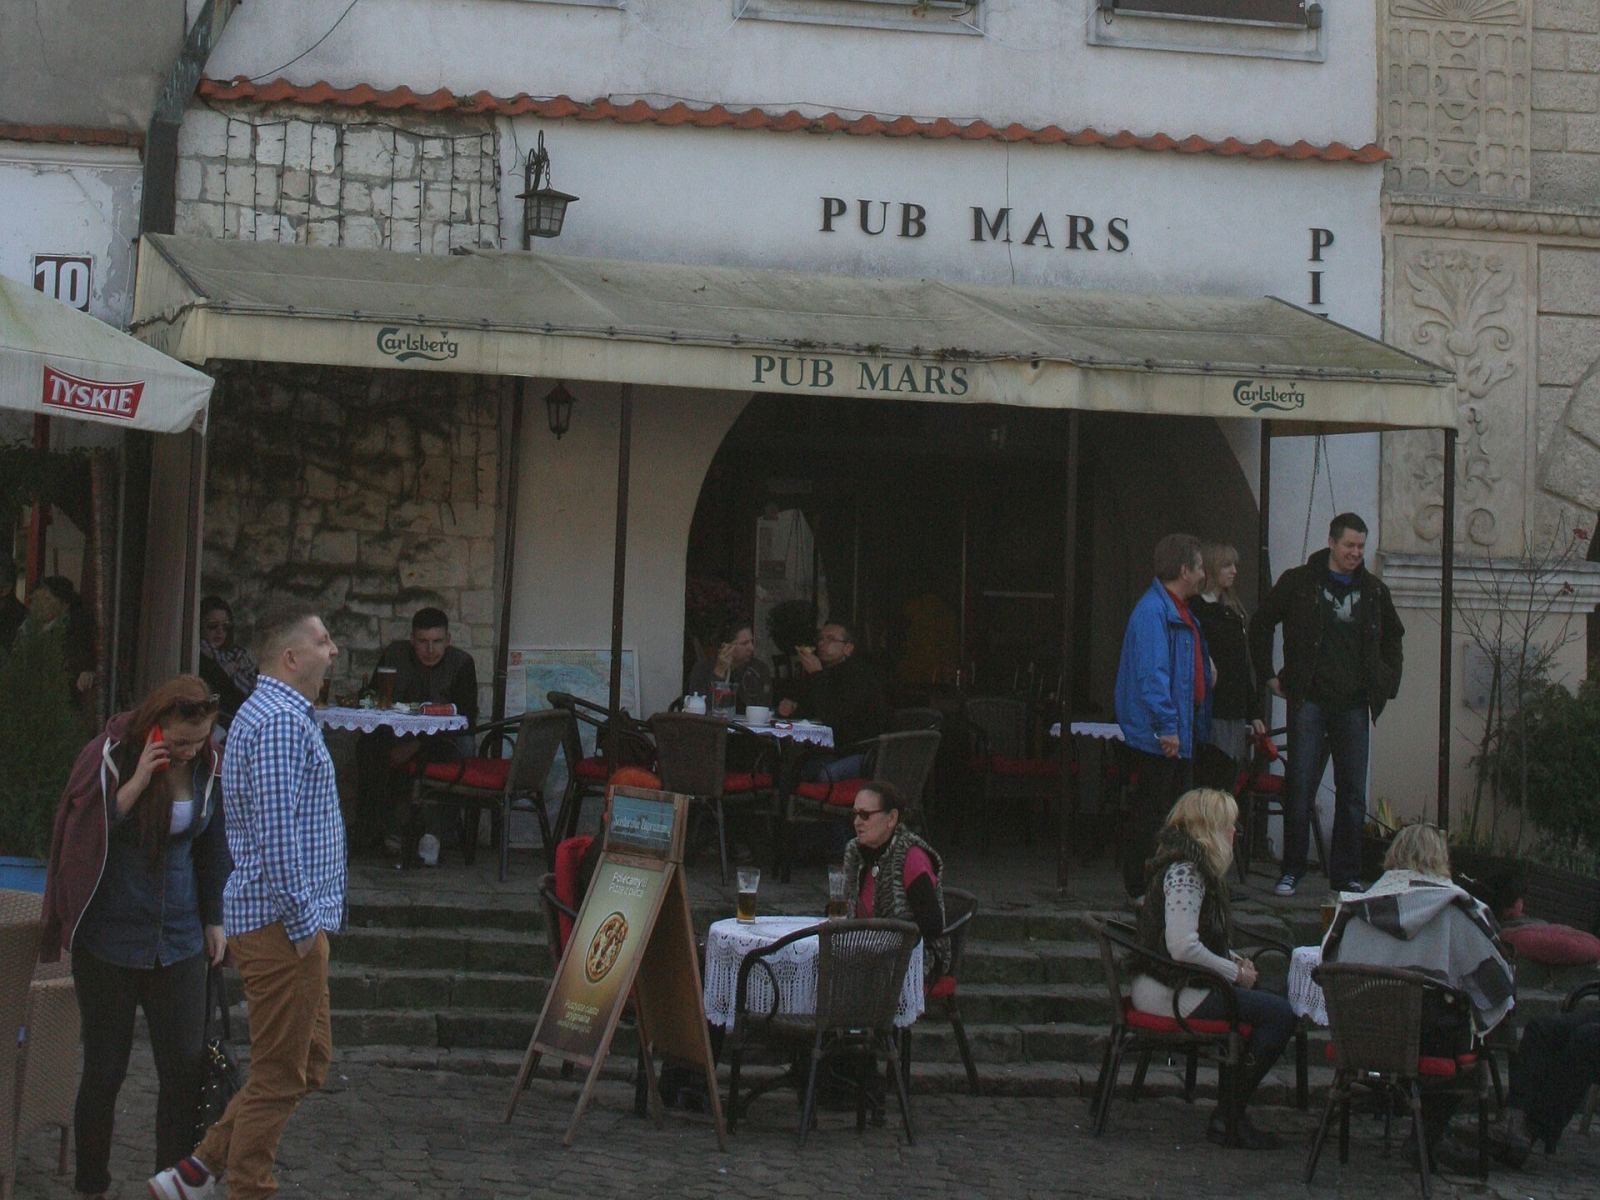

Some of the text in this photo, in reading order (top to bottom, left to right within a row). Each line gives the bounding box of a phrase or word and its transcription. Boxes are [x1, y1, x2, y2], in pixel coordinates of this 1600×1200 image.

[819, 196, 1130, 253] PUB MARS
[35, 260, 89, 309] 10
[1307, 227, 1334, 319] PI
[377, 327, 459, 362] Carlsberg
[49, 374, 135, 414] TYSKIE
[752, 354, 969, 396] PUB MARS
[1233, 380, 1305, 412] Carlsberg
